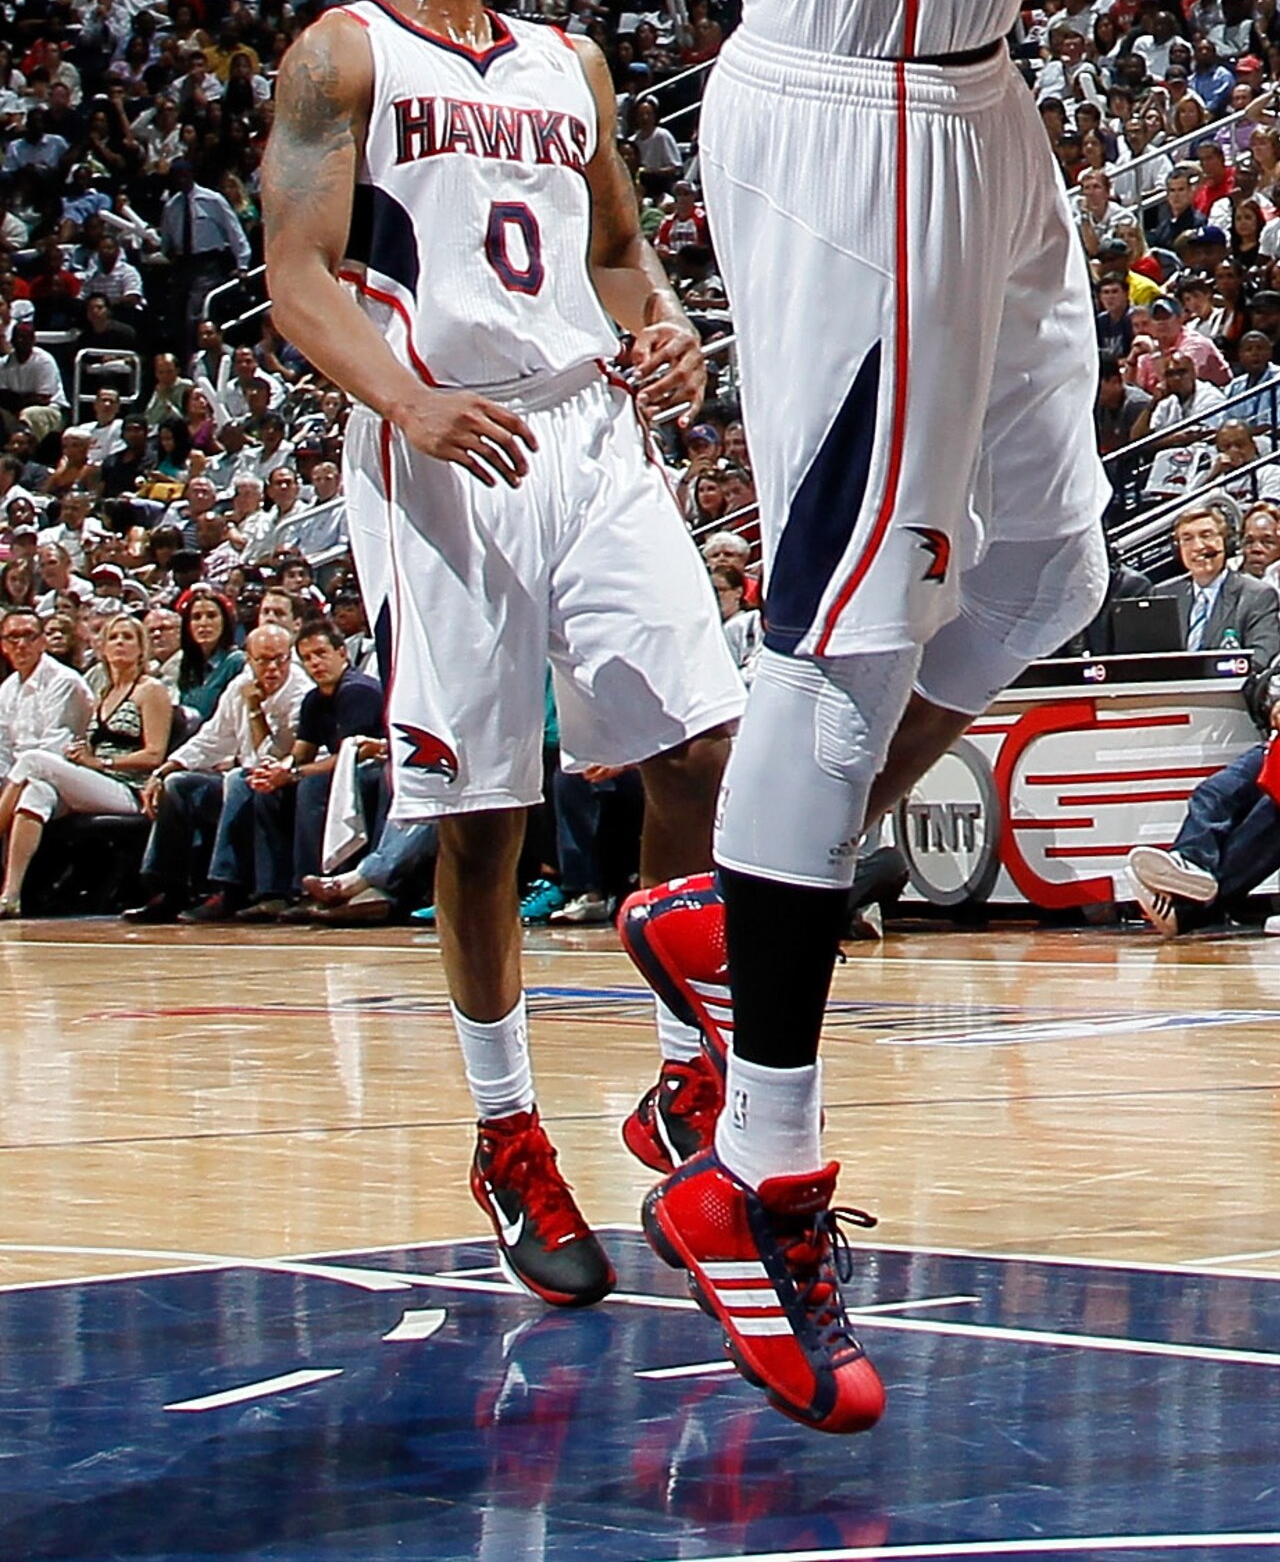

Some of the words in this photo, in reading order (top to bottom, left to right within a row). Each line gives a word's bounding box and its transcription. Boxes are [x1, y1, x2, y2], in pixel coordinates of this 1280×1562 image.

[393, 96, 588, 173] HAWKS
[484, 200, 545, 297] 0
[907, 802, 981, 853] TNT
